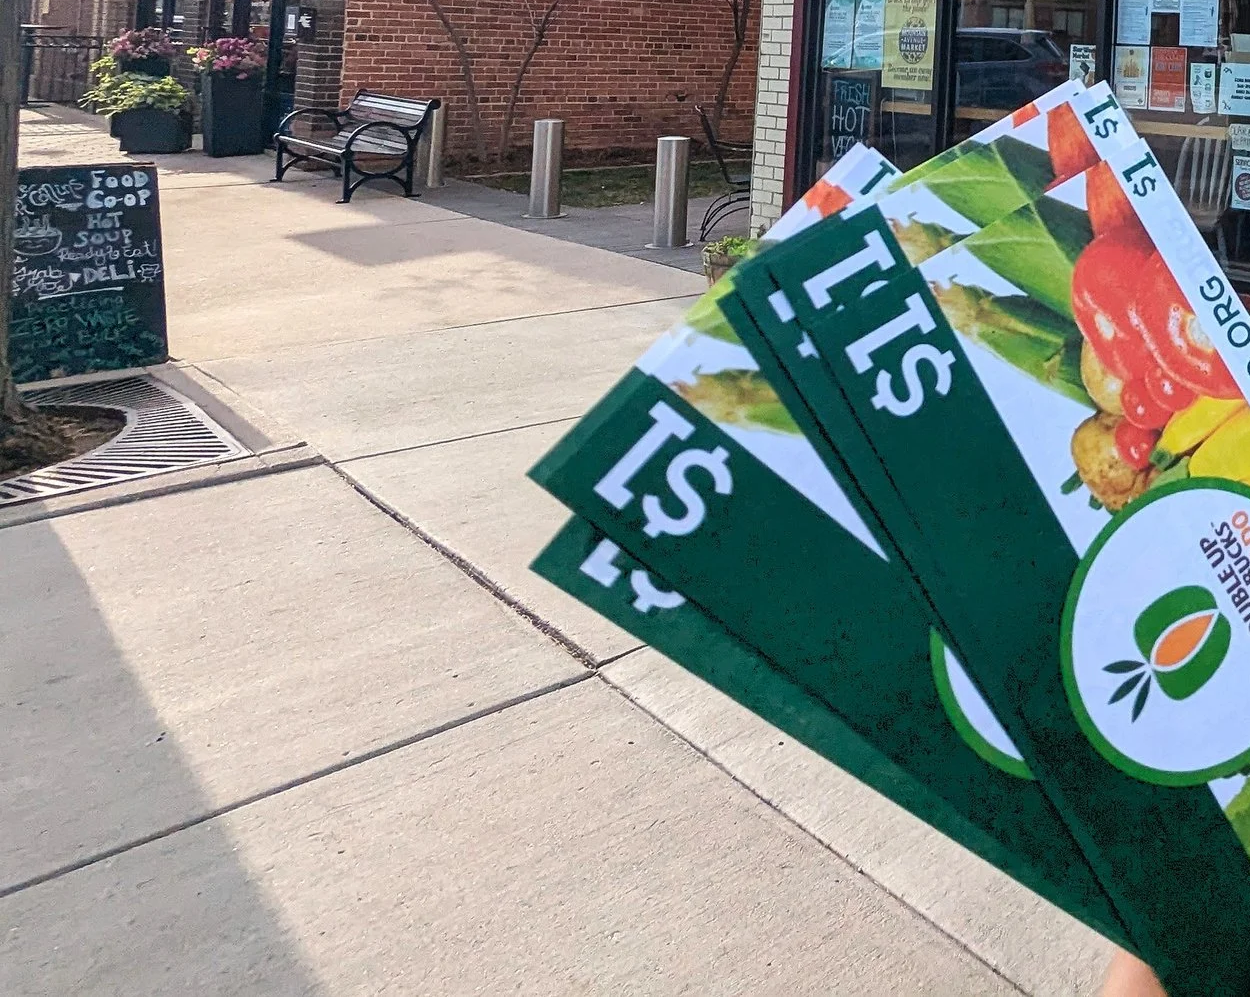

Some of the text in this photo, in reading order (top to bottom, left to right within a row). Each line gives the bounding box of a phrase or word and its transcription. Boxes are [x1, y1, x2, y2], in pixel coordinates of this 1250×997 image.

[900, 43, 926, 51] MARKET
[832, 80, 871, 106] FRESH
[831, 104, 872, 137] HOT
[1083, 94, 1119, 139] $1
[1121, 151, 1158, 198] $1
[73, 228, 133, 248] SOUP
[844, 292, 957, 417] $1
[593, 400, 733, 539] $1
[1199, 537, 1225, 569] UP
